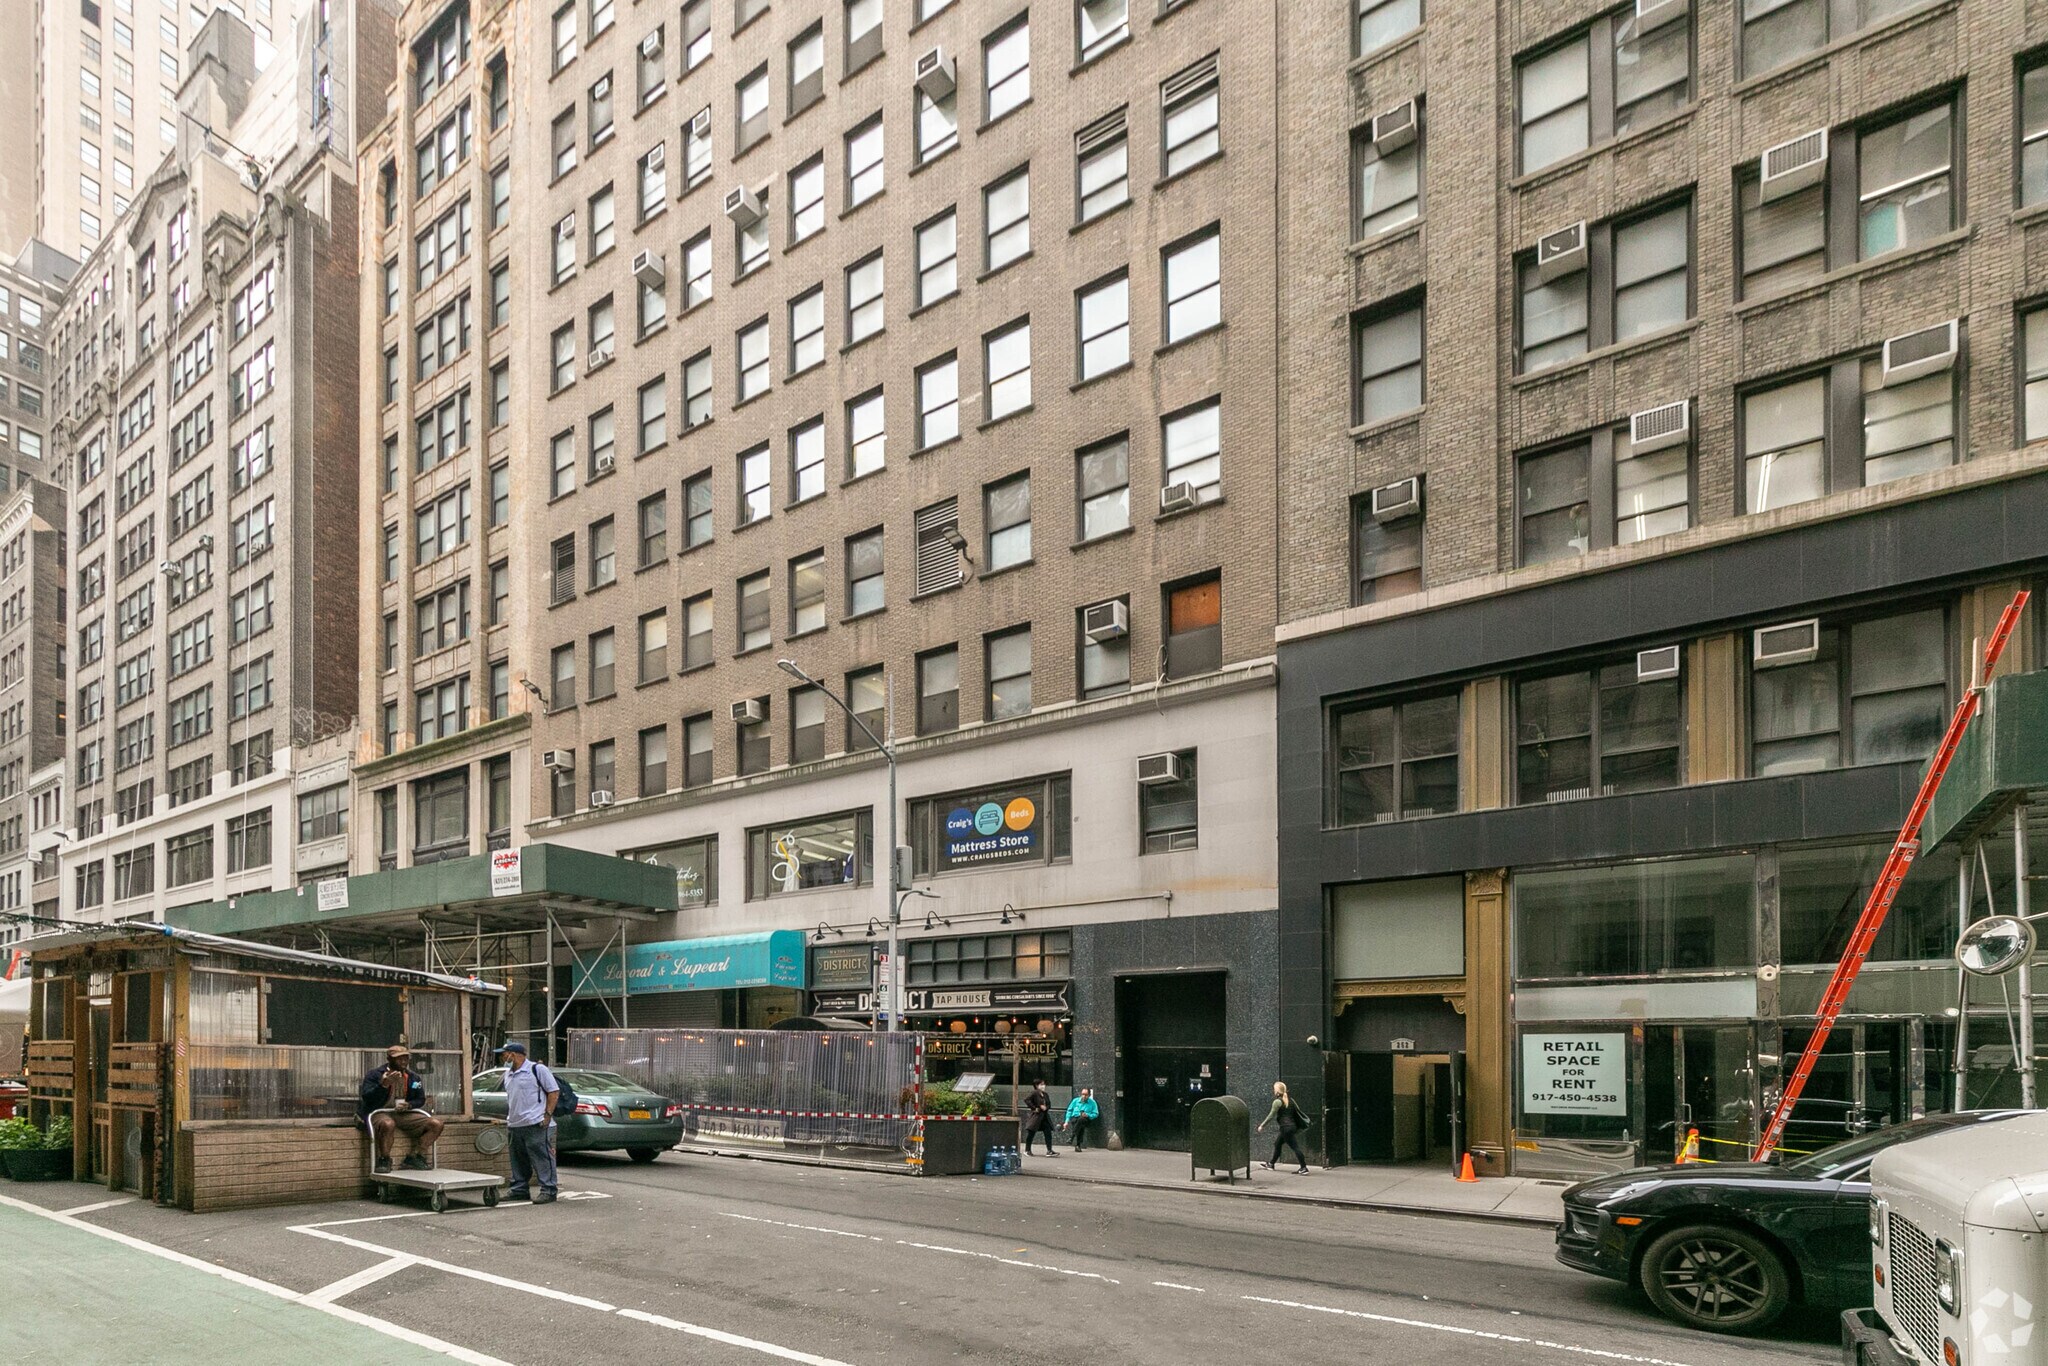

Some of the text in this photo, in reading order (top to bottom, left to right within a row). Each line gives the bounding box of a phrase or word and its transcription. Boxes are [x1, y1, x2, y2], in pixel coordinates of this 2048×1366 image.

[1010, 809, 1029, 819] Beds
[948, 818, 972, 829] Craig's
[951, 835, 1029, 854] Mattress Store
[951, 848, 1030, 863] WWW.CRAIGSBEDS.COM
[676, 866, 699, 881] tudios
[658, 966, 666, 976] &
[671, 956, 731, 978] Lupearl
[823, 958, 862, 971] DISTRICT
[858, 991, 927, 1011] DIICT
[936, 995, 952, 1004] TAP
[956, 994, 986, 1004] HOUSE
[928, 1043, 966, 1054] DISTRICT
[1009, 1042, 1050, 1054] DSTRICT
[1543, 1041, 1604, 1052] RETAIL
[1546, 1055, 1601, 1066] SPACE
[1552, 1079, 1596, 1089] RENT
[1532, 1093, 1617, 1102] 917-450-4538
[703, 1121, 727, 1134] TAP
[733, 1123, 780, 1138] HOUSE
